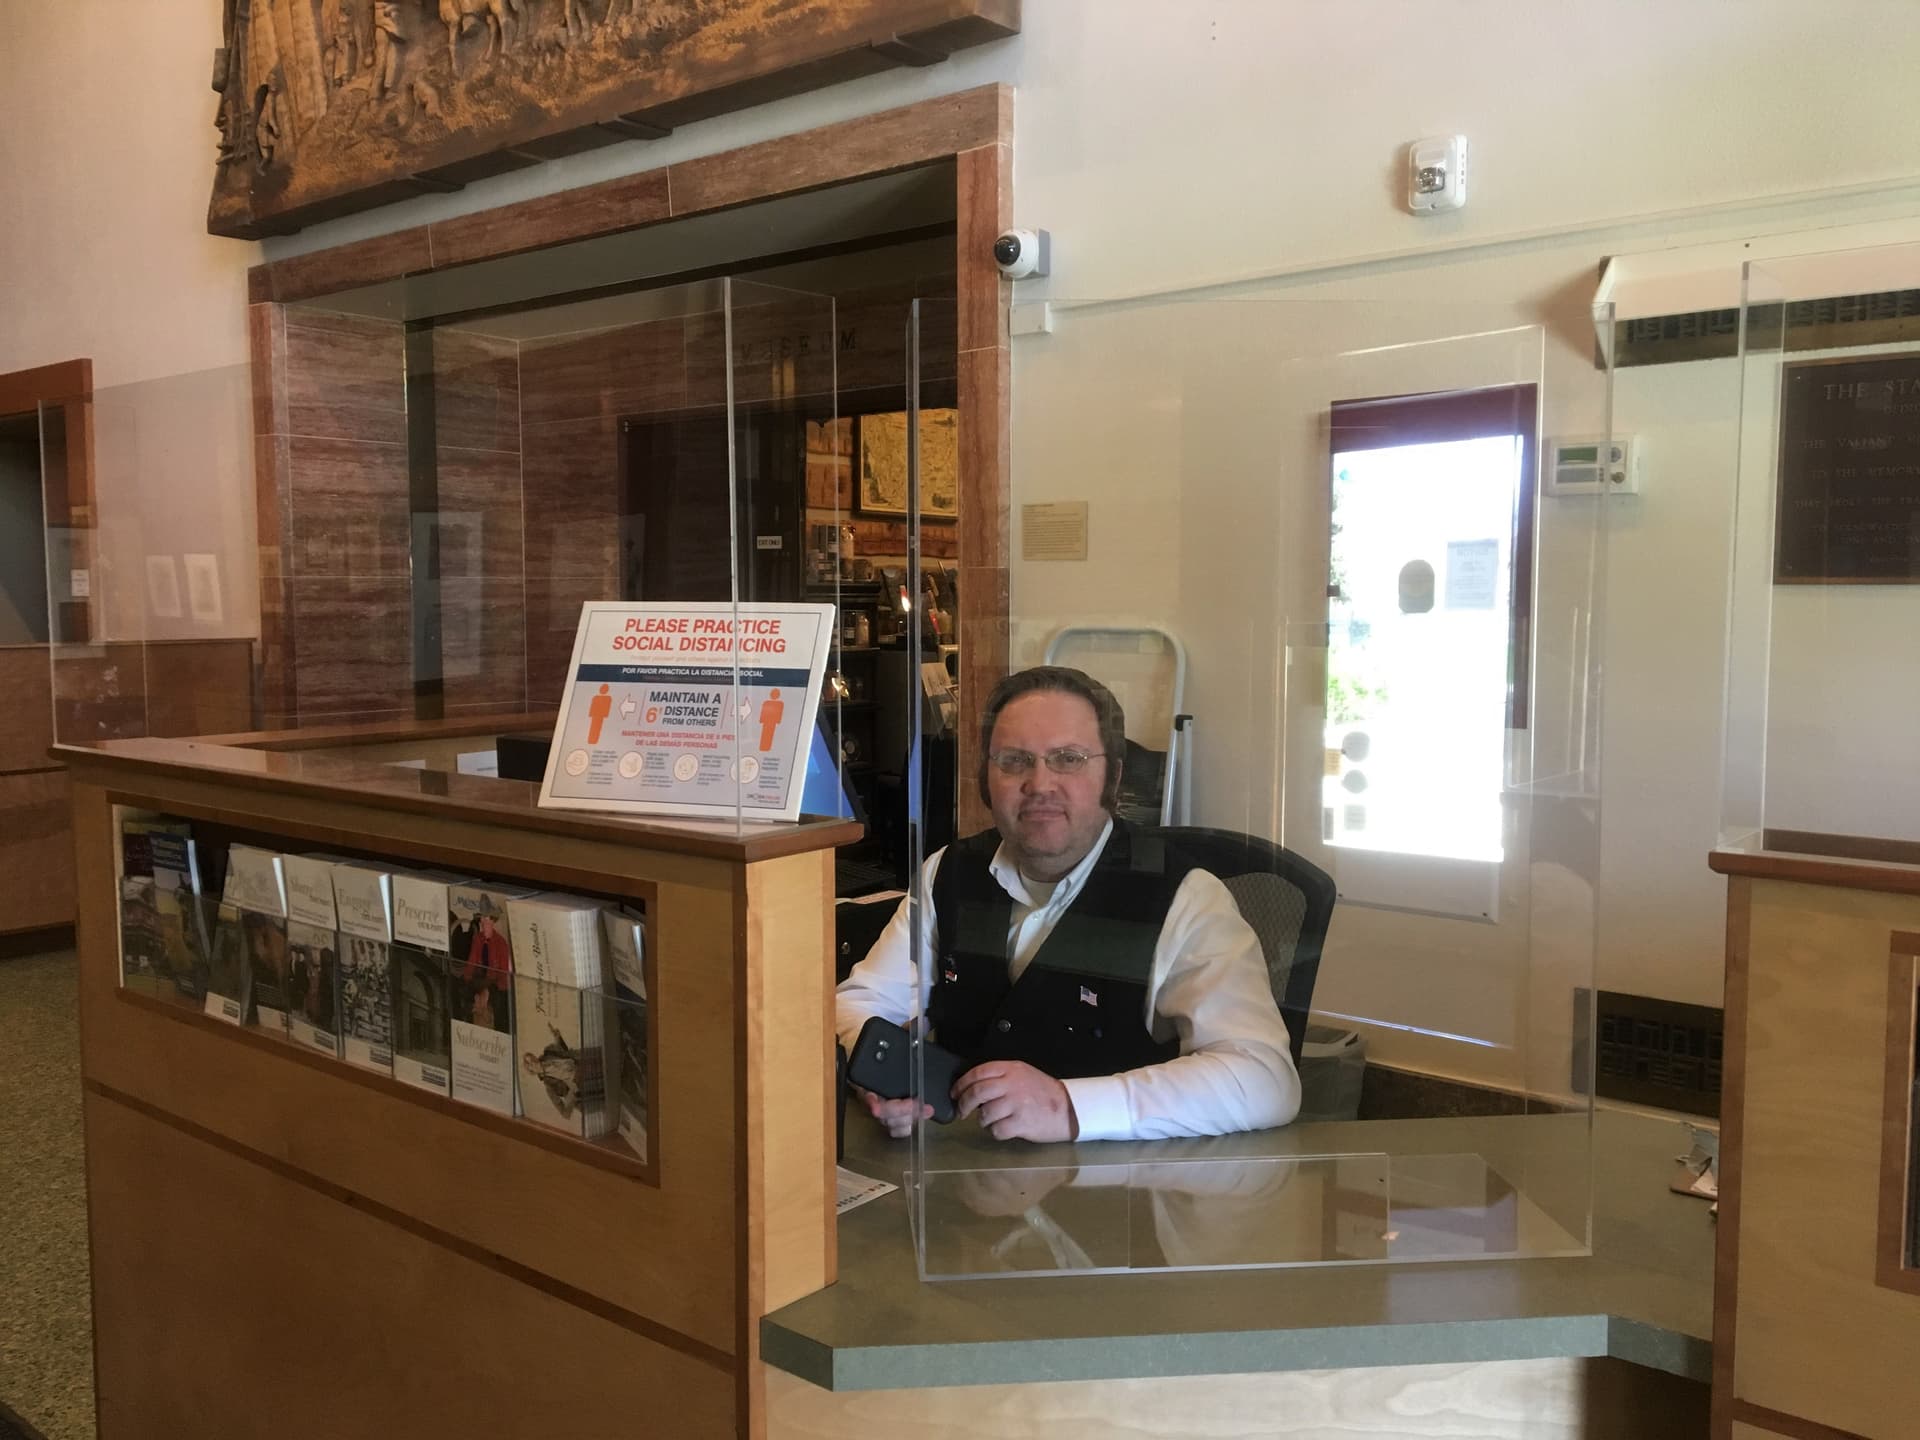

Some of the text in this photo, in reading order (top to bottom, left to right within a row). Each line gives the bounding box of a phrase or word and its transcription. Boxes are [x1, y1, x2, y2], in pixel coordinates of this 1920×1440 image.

[1822, 382, 1866, 400] THE
[624, 618, 781, 635] PLEASE PRACTICE
[612, 636, 787, 653] SOCIAL DISTANCING
[622, 667, 636, 675] POR
[637, 667, 657, 675] FAVOR
[658, 668, 690, 676] PRACTICA
[691, 669, 700, 677] LA
[740, 671, 764, 679] SOCIAL
[649, 691, 722, 705] MAINTAIN A
[664, 706, 720, 718] DISTANCE
[662, 718, 717, 727] FROM OTHERS
[671, 731, 704, 739] DISTANCIA
[397, 897, 440, 923] Preserve
[455, 1026, 507, 1057] Subscribe
